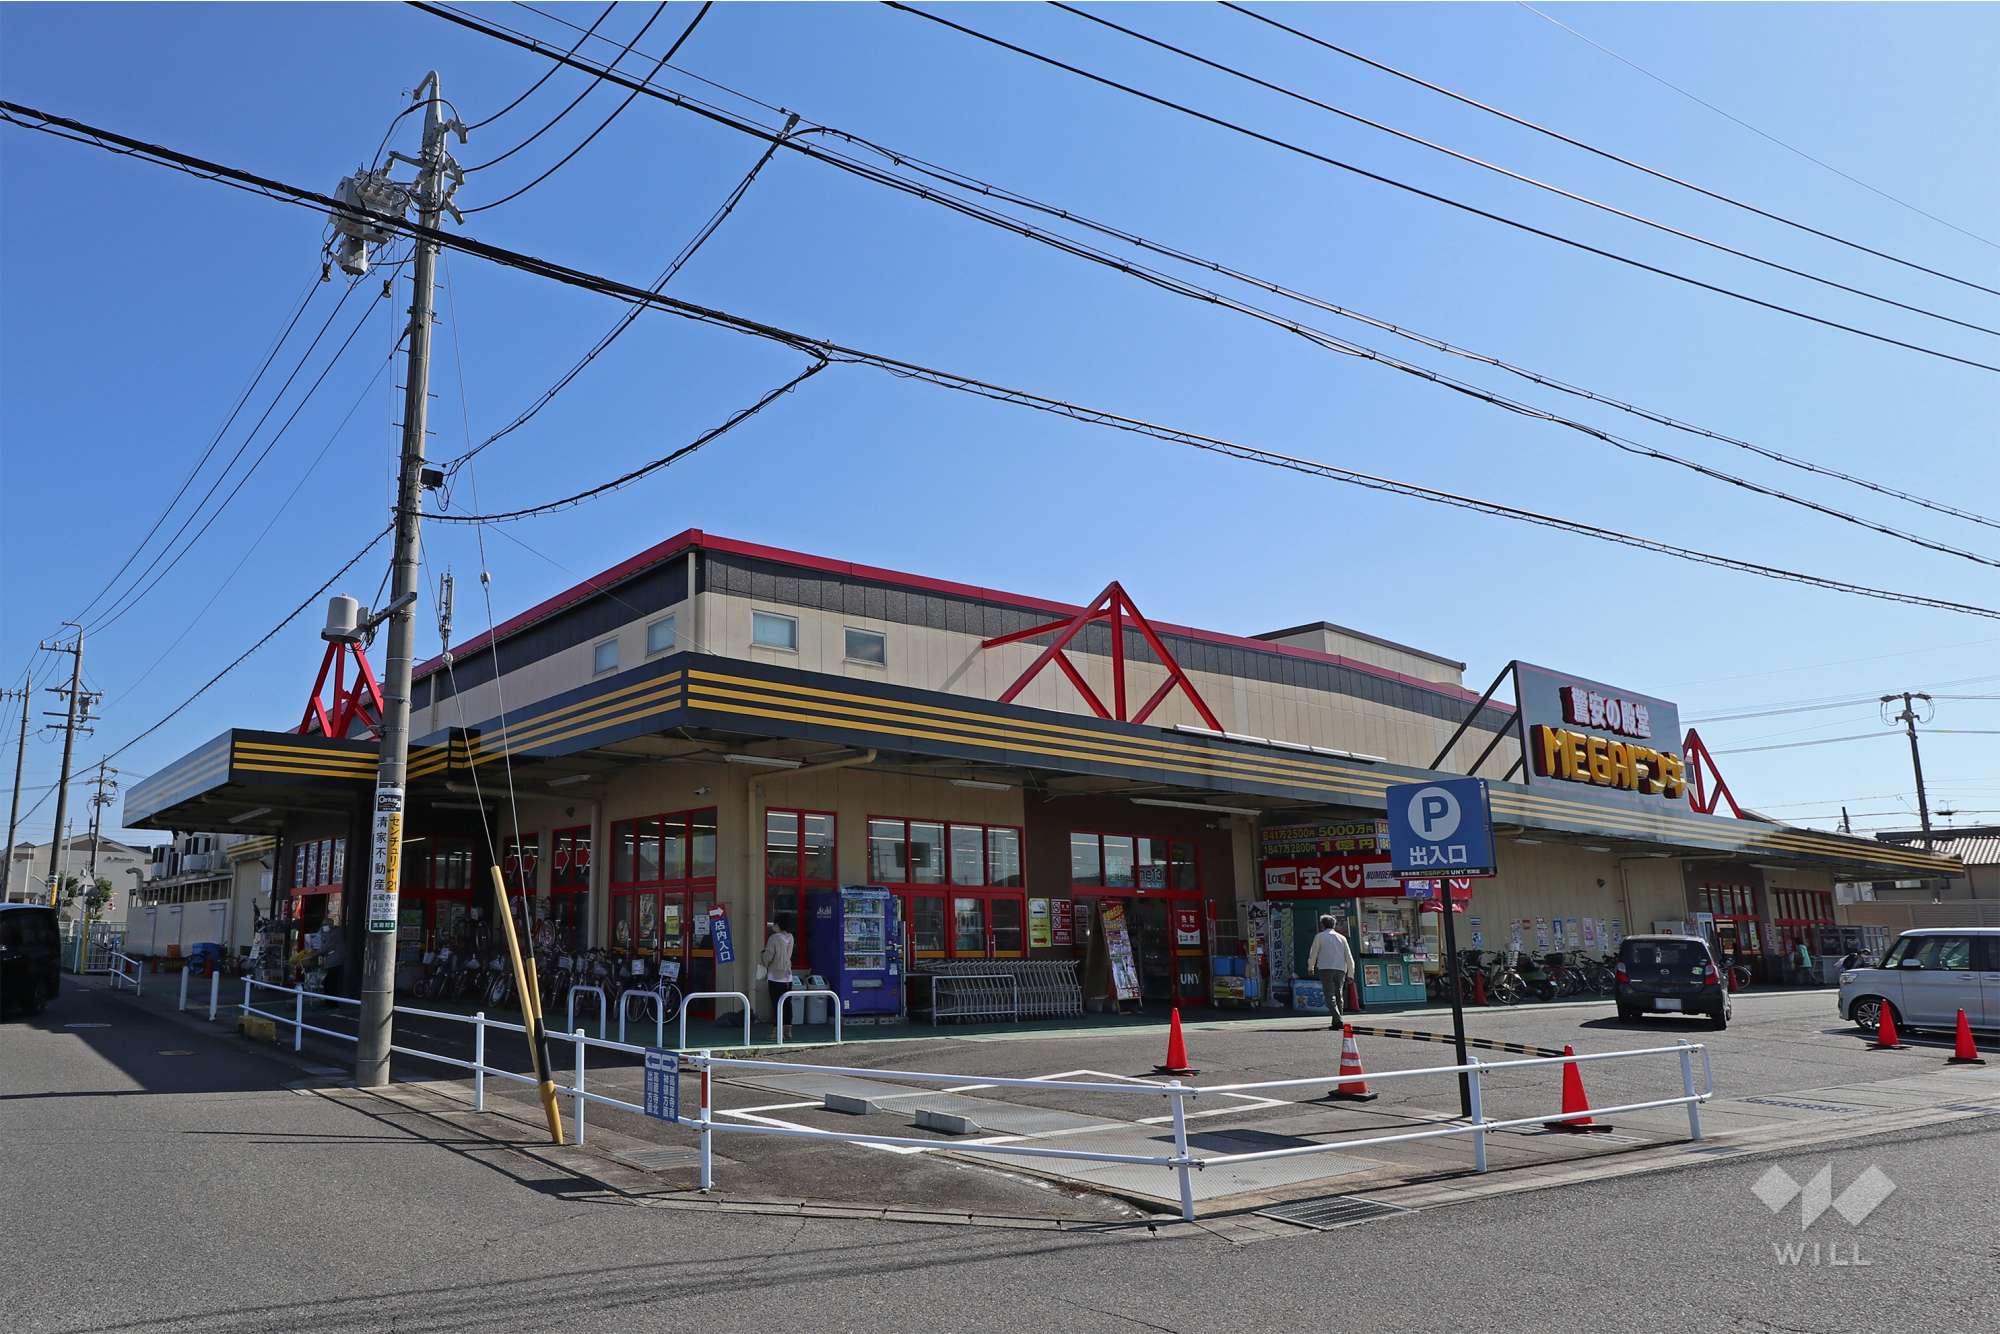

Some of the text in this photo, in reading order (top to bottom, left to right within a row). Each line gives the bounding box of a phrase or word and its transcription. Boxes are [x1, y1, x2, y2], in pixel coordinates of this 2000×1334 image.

[1569, 686, 1652, 738] 驚安の殿堂
[1540, 724, 1687, 799] MEGAドンキ
[1318, 824, 1374, 836] 5000万円
[1422, 796, 1449, 832] P
[374, 816, 388, 890] 清家不動産
[387, 816, 400, 890] センチュリー21
[1409, 844, 1467, 865] 出入口
[1299, 864, 1361, 890] 宝くじ
[715, 920, 731, 961] 店内入口
[1180, 973, 1199, 984] UNY
